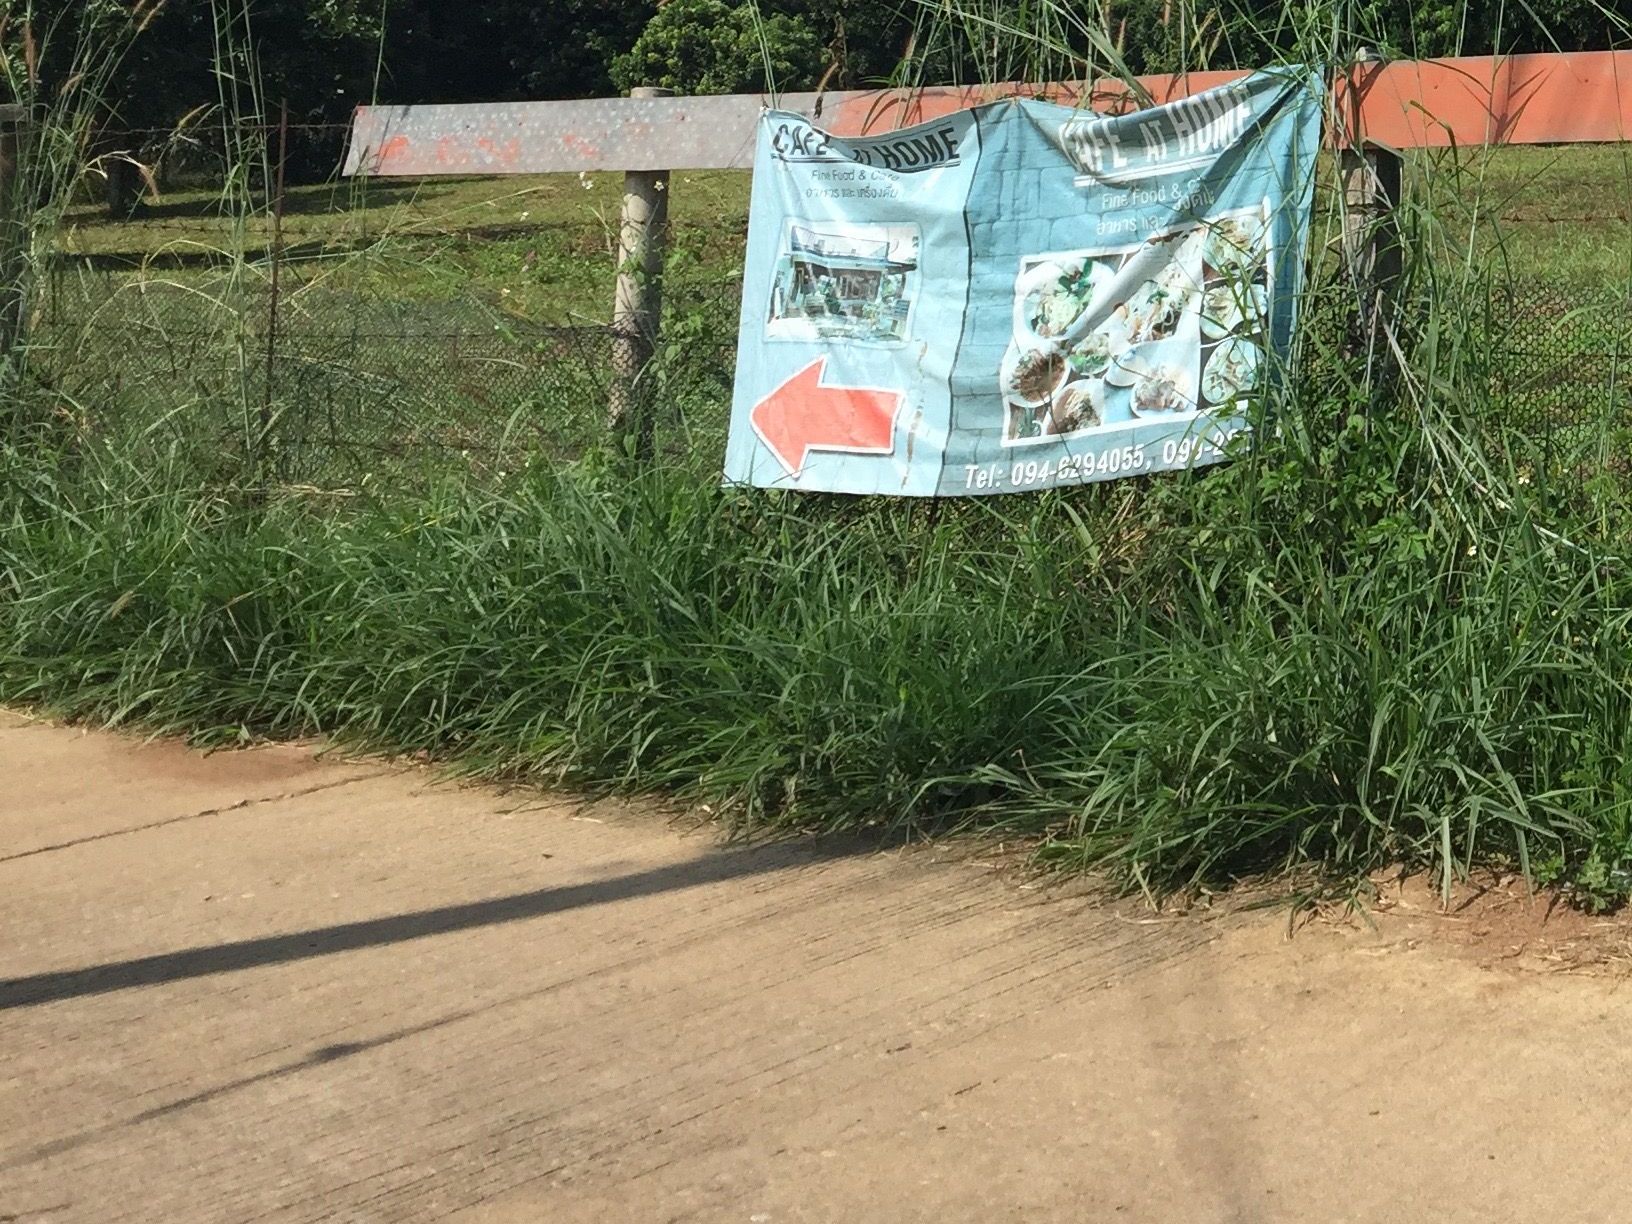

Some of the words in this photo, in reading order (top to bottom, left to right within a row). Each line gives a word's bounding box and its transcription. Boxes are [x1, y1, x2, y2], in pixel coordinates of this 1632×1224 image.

[872, 126, 961, 169] HOME
[1138, 119, 1168, 163] AT
[858, 169, 867, 182] &
[1102, 193, 1129, 211] Fine
[1132, 185, 1166, 205] Food
[1171, 183, 1182, 201] &
[964, 464, 1001, 489] Tel:
